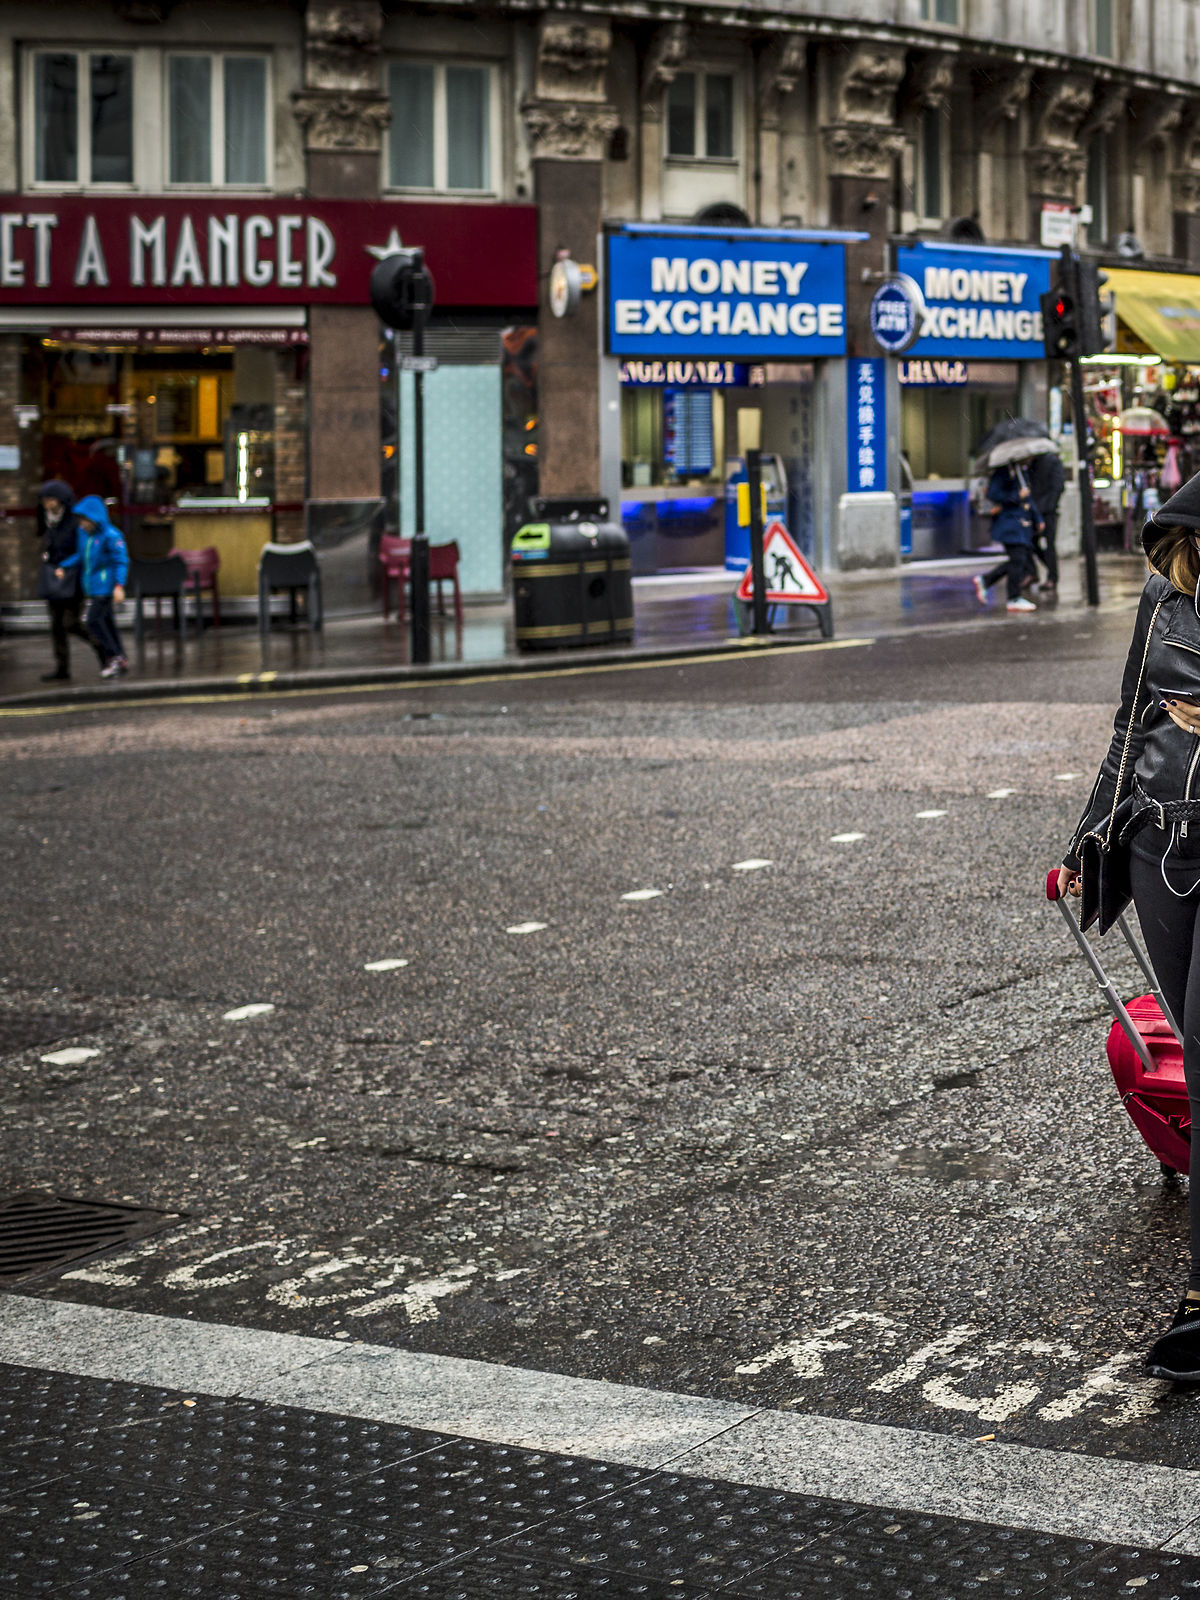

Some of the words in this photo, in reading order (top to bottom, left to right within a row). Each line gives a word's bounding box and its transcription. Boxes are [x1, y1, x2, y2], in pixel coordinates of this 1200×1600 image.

[75, 215, 109, 287] A
[130, 214, 337, 288] MANGER
[651, 257, 809, 296] MONEY
[924, 266, 1028, 304] MONEY
[615, 299, 844, 336] EXCHANGE
[918, 306, 1045, 341] XCHANGE
